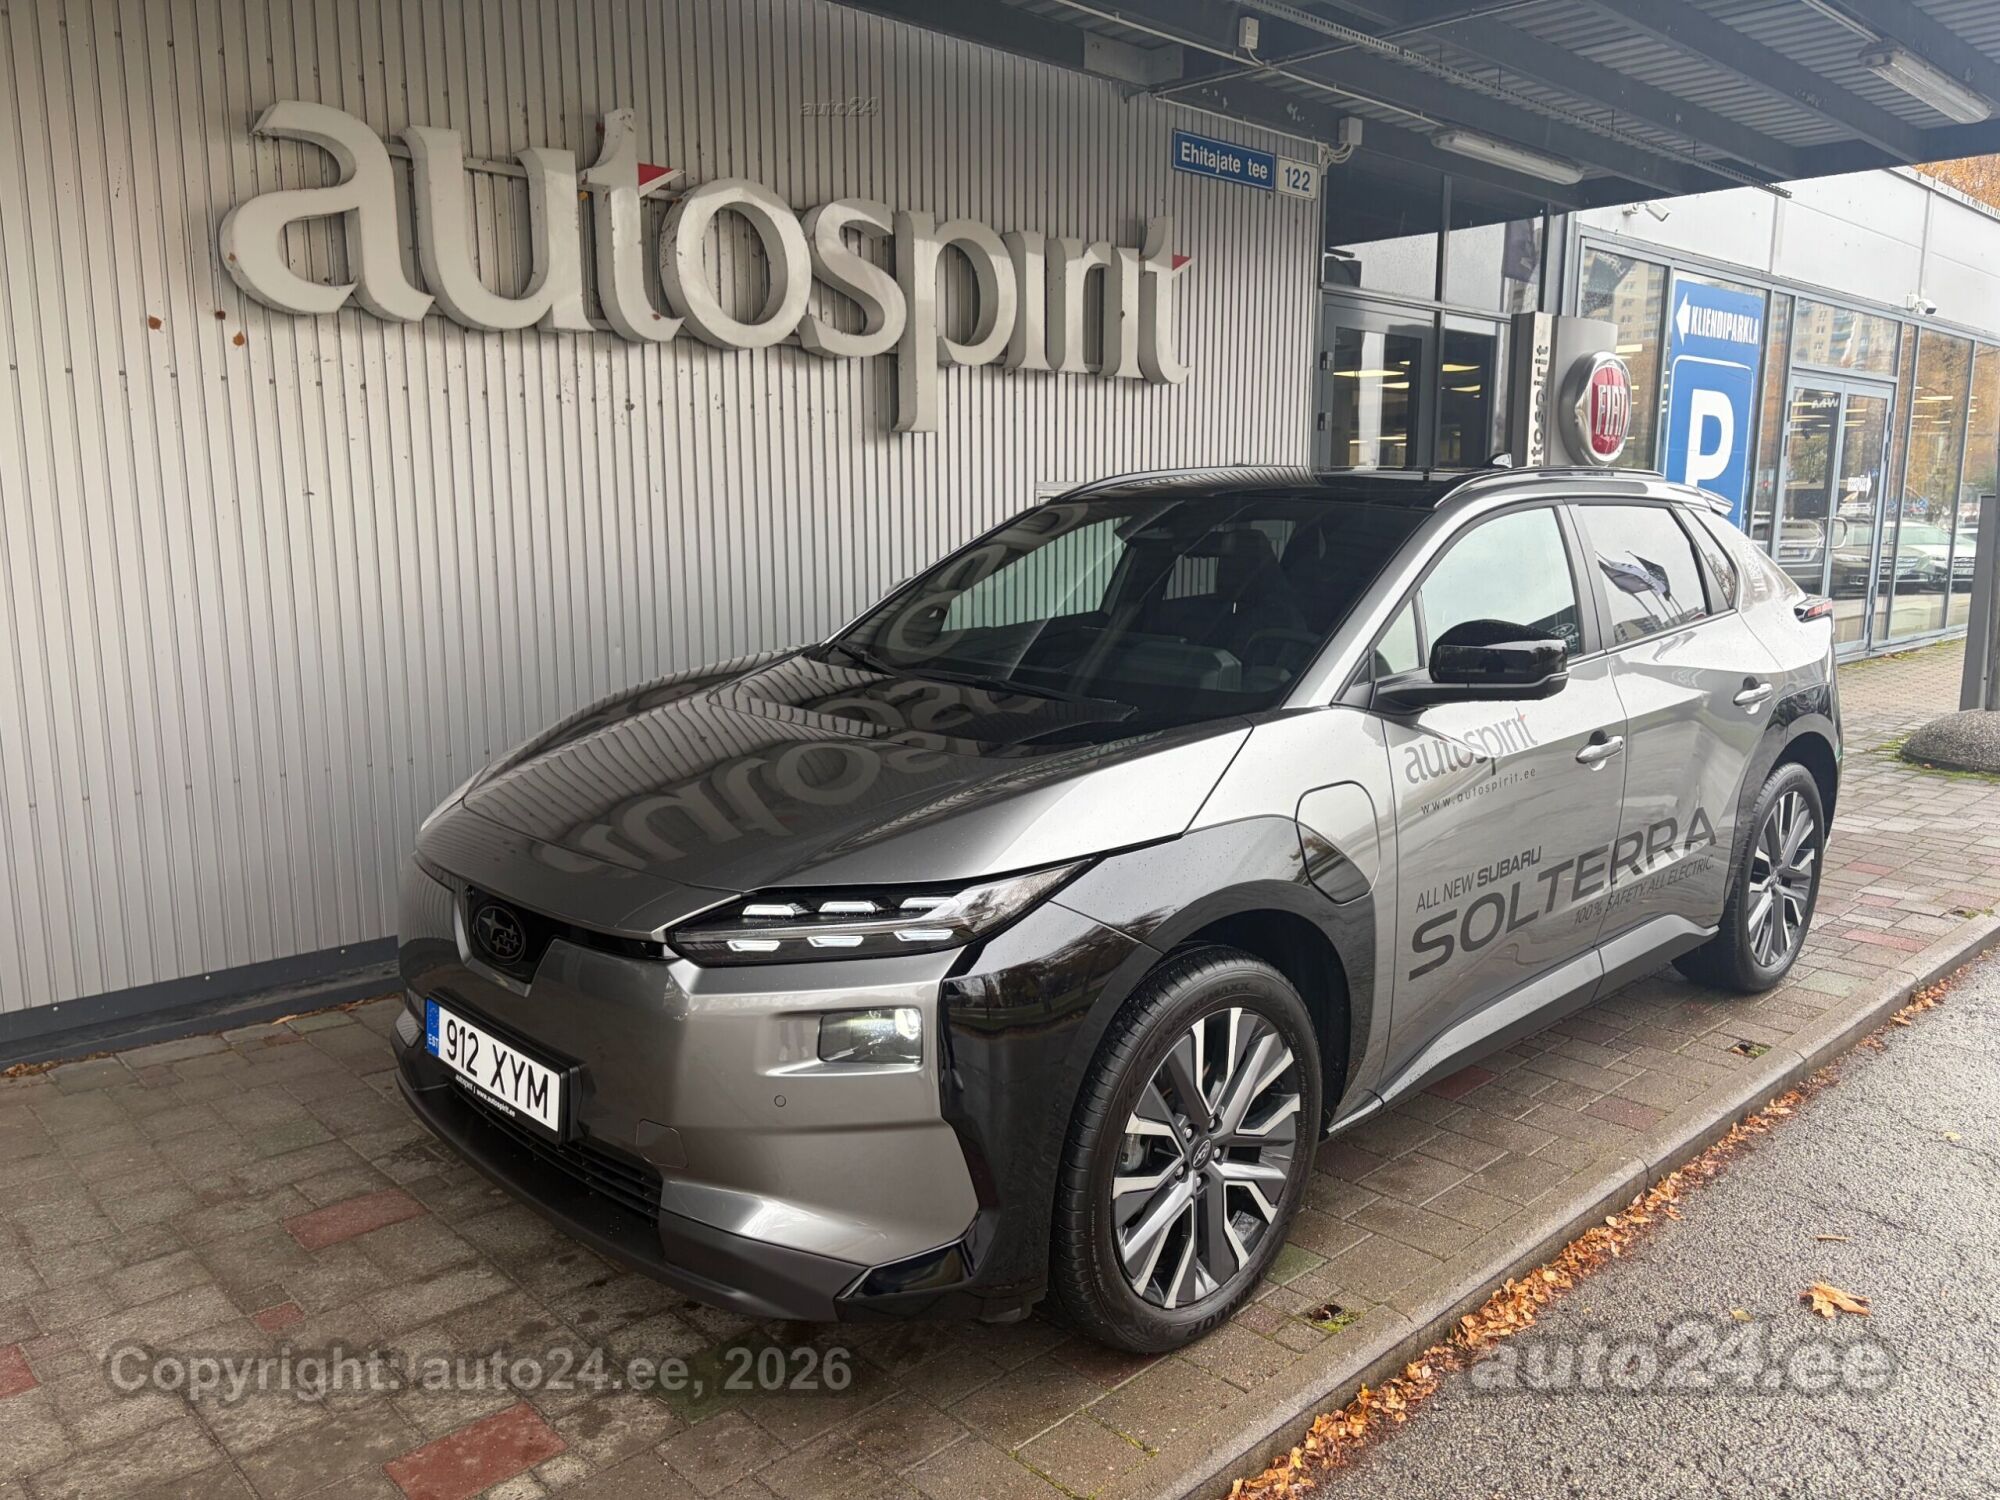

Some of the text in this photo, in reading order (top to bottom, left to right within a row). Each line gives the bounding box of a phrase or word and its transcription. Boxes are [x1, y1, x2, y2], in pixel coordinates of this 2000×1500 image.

[1181, 141, 1268, 180] Ehitajate tee
[1285, 166, 1311, 192] 122
[220, 99, 1189, 432] autospirit
[1691, 305, 1760, 344] KLIENDIPARKLA
[1596, 385, 1627, 436] FIAT
[1685, 389, 1735, 489] P
[1404, 707, 1538, 785] autospirit
[1420, 767, 1536, 815] www.autospirit.ee
[1408, 806, 1718, 982] SOLTERRA
[1416, 845, 1541, 913] ALL NEW SUBARU
[1574, 897, 1604, 926] 100%
[1648, 873, 1665, 892] ALL
[1667, 854, 1714, 885] ELECTRIC.
[428, 1018, 549, 1120] EST 912 XYM
